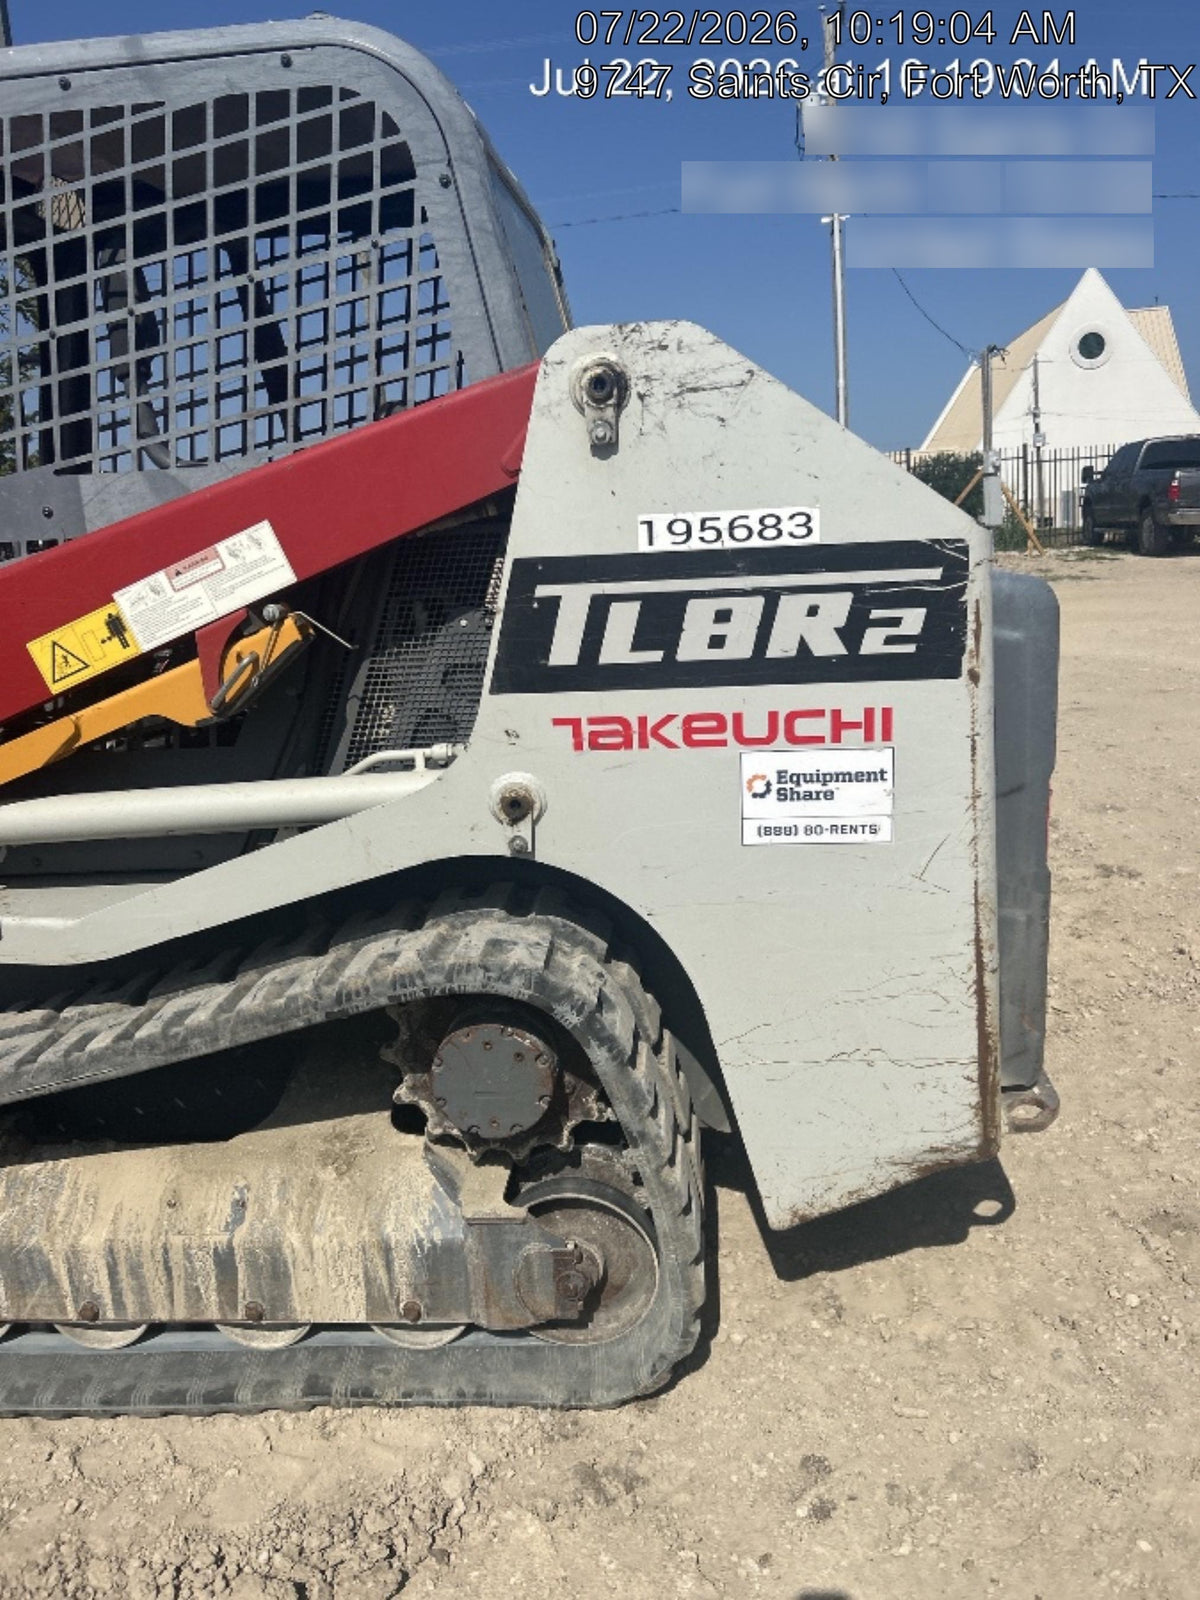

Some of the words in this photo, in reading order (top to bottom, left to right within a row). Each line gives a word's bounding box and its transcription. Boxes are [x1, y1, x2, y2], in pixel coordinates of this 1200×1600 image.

[639, 512, 815, 547] 195683
[776, 768, 888, 787] Equipment
[776, 787, 835, 802] Share
[757, 824, 799, 838] (888)
